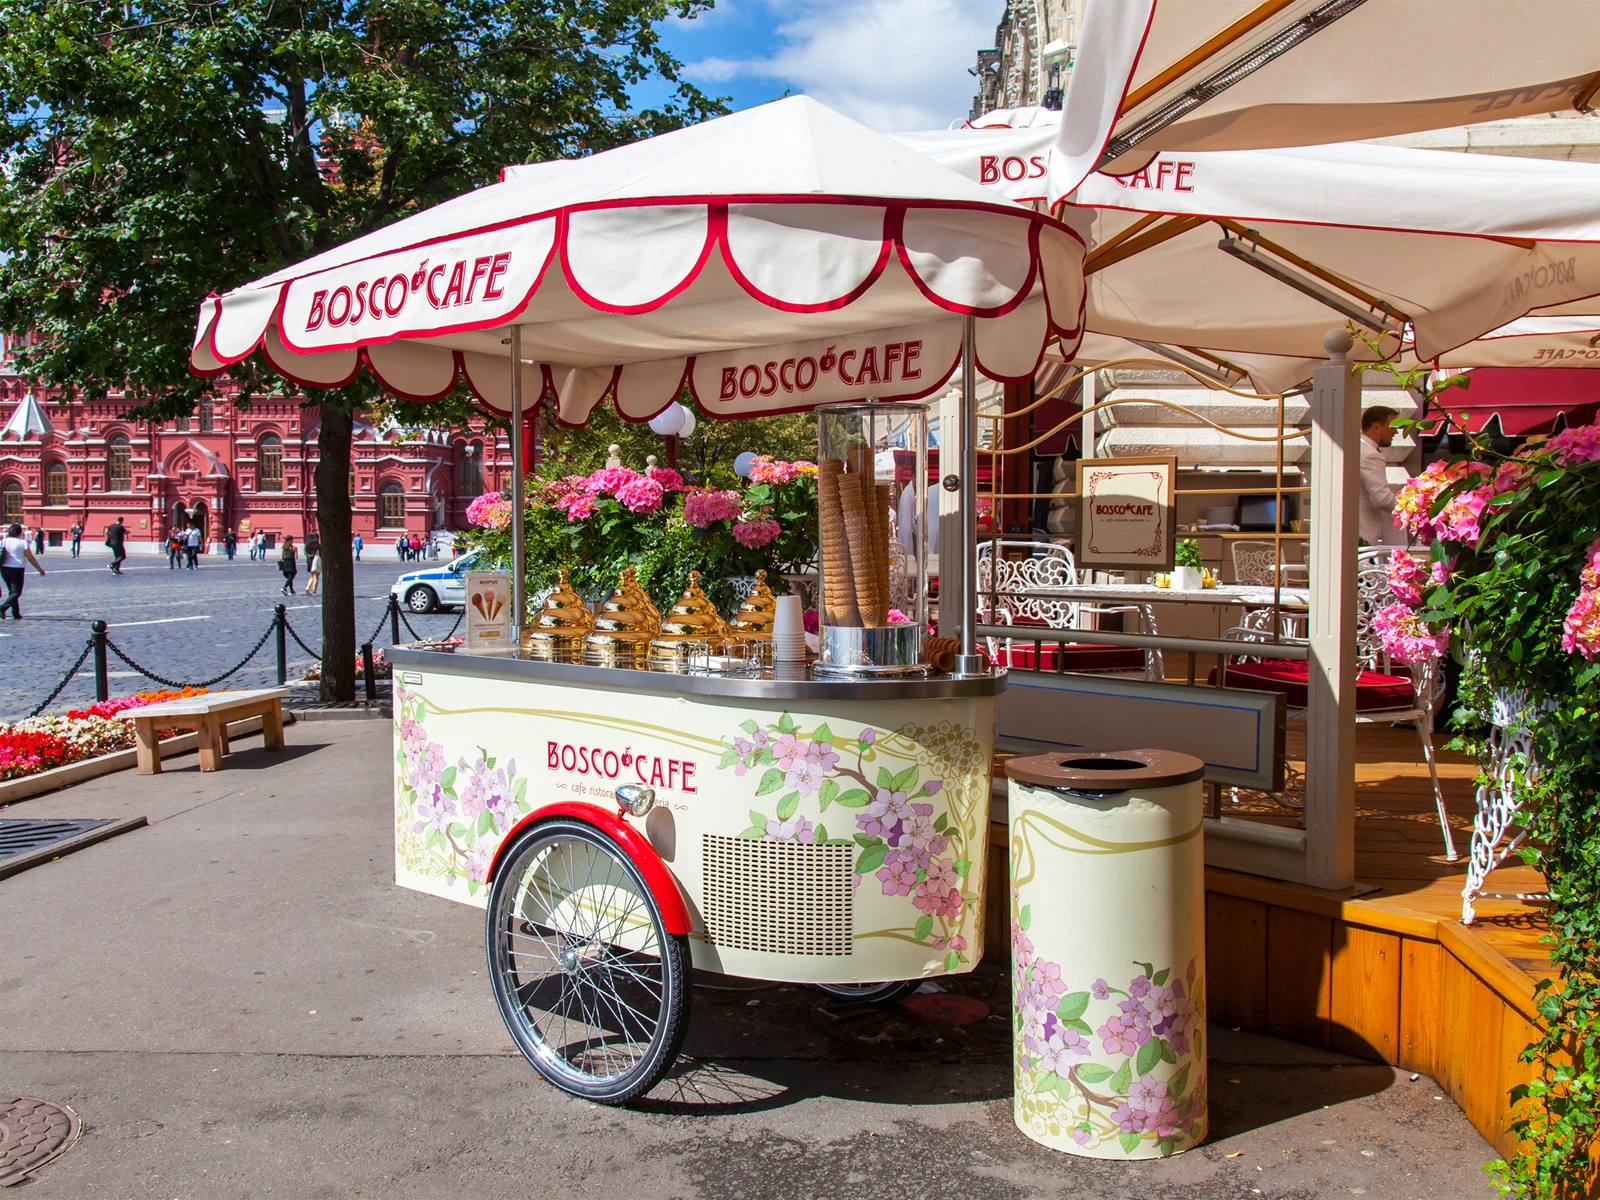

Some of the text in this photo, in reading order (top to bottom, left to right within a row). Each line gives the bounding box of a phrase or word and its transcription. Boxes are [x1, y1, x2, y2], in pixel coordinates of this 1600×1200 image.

[980, 156, 1047, 185] BOS
[305, 251, 512, 332] BOSCO CAFE
[719, 340, 922, 401] BOSCO CAFE
[1096, 504, 1154, 516] BOSCO CAFE
[547, 740, 698, 794] BOSCO CAFE
[571, 782, 615, 799] cafe ristora
